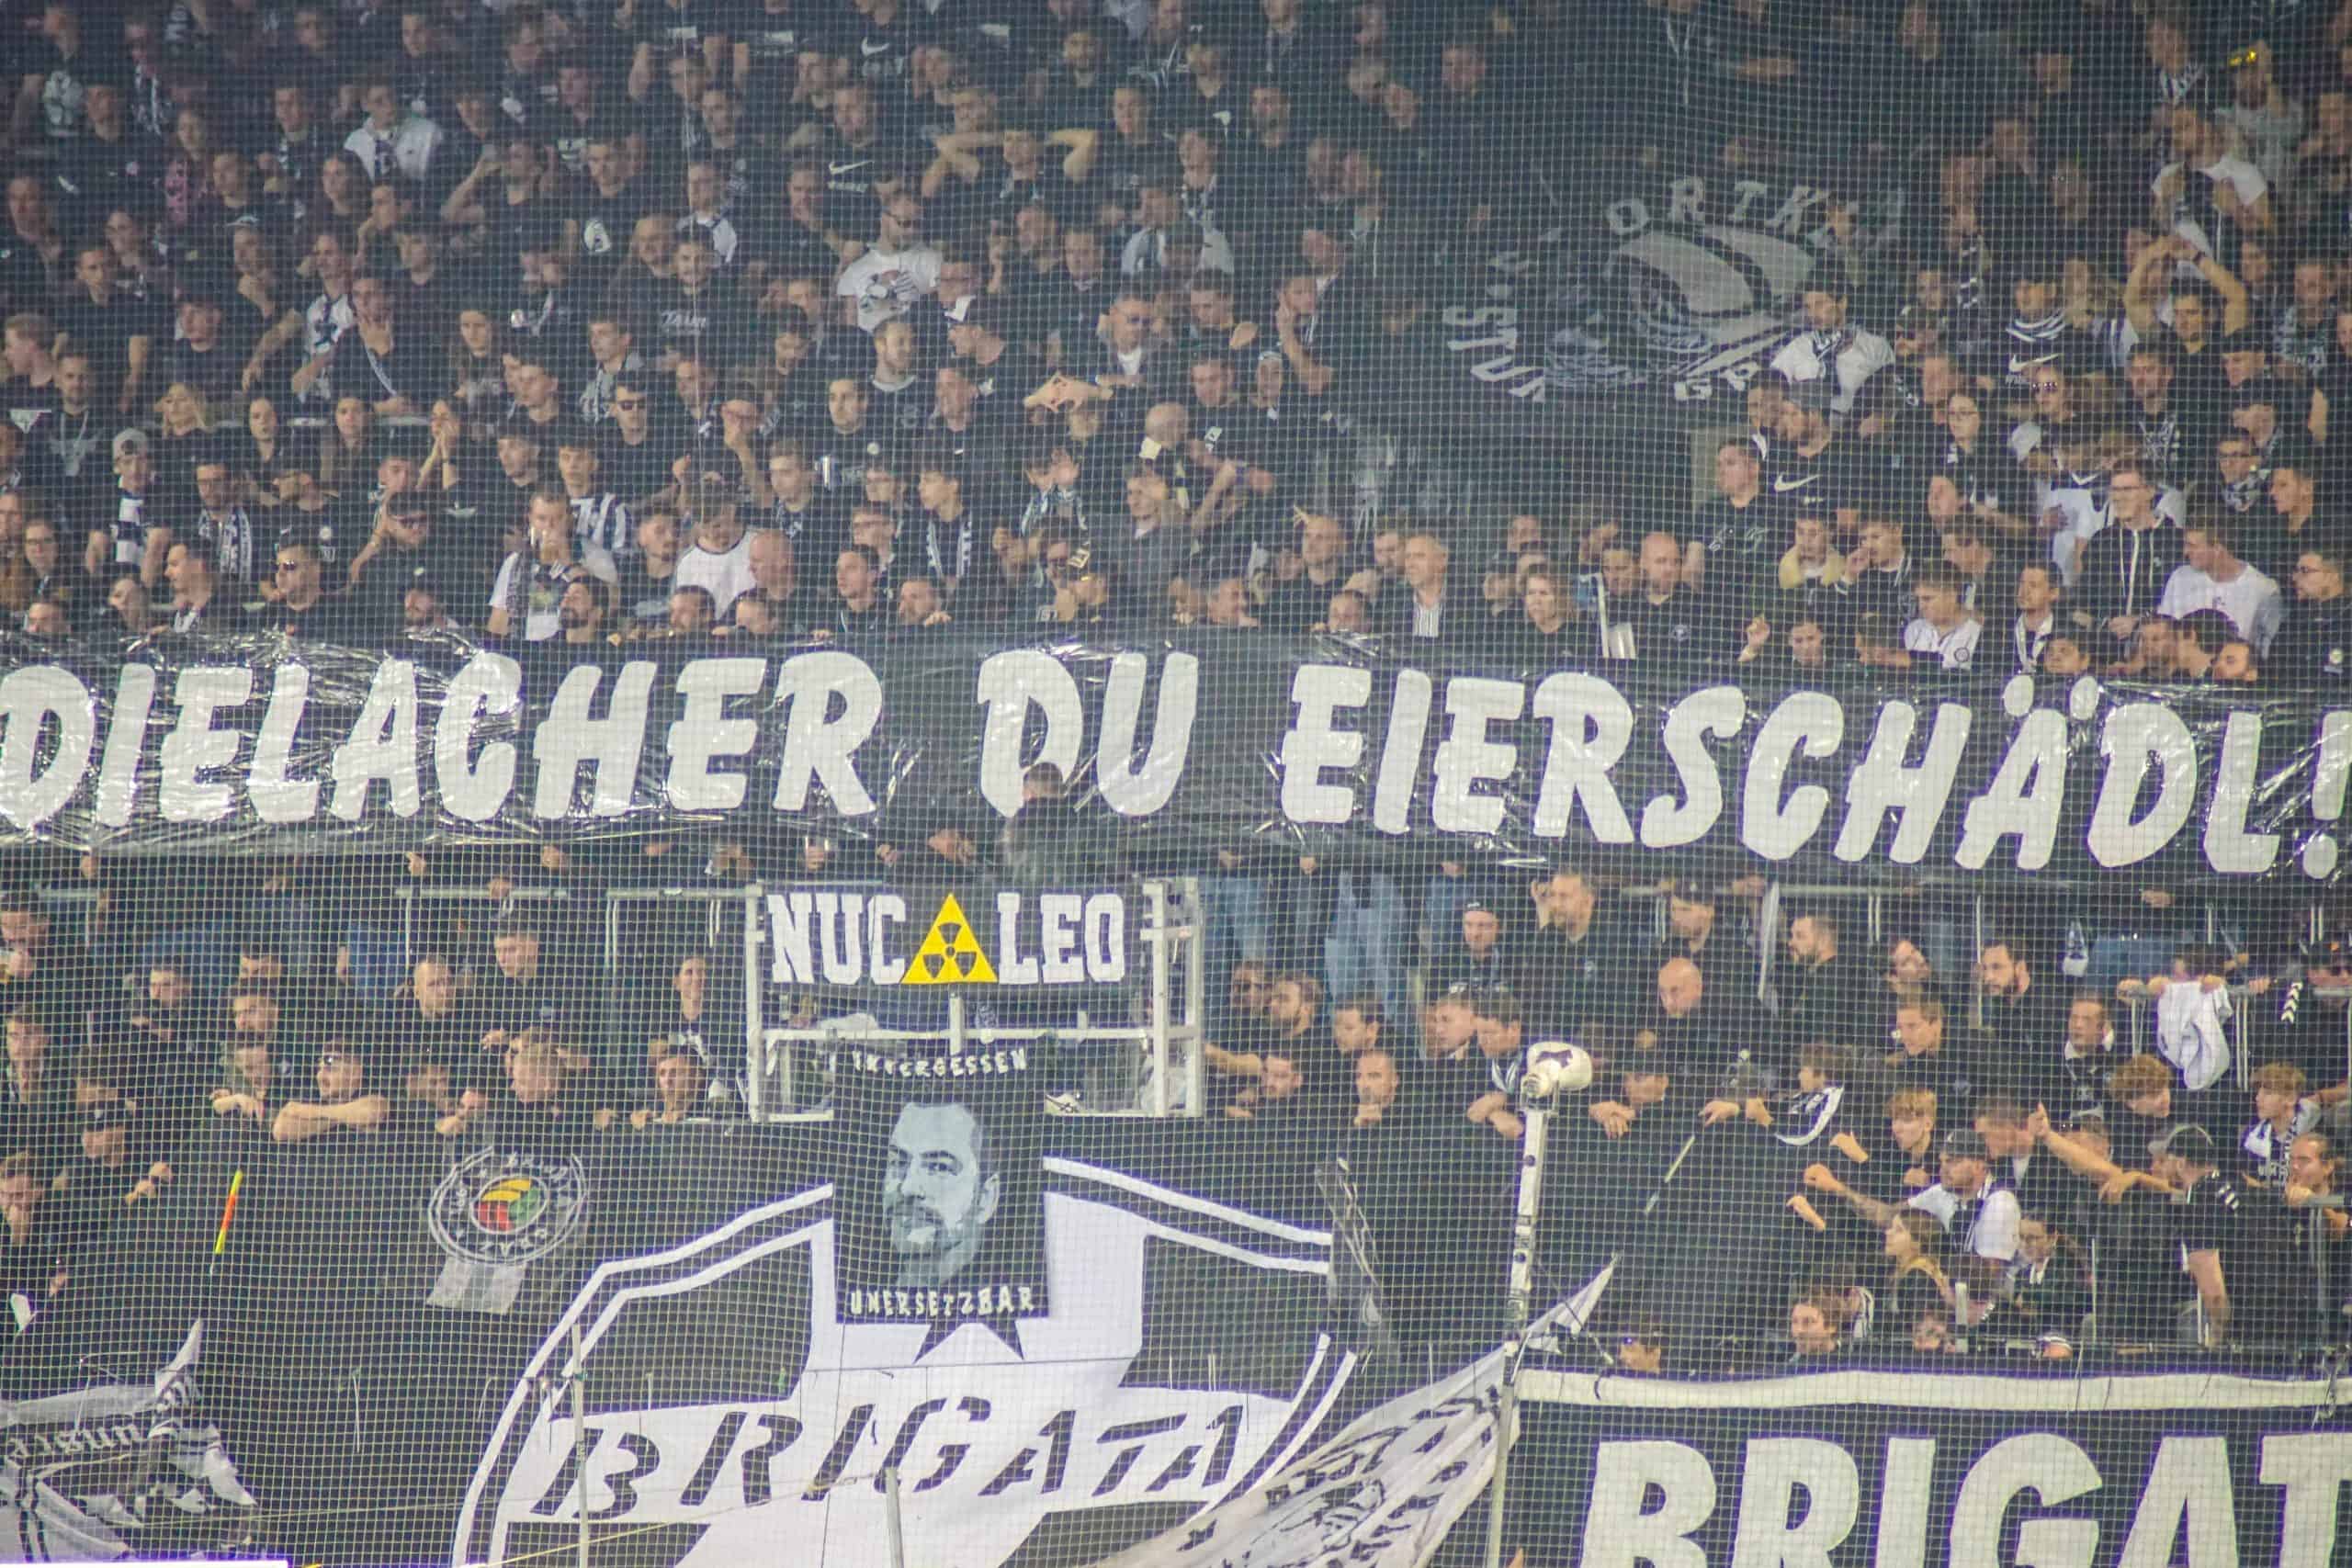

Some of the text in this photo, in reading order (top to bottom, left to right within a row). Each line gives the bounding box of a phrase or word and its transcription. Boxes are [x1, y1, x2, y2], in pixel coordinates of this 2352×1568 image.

[0, 649, 2352, 879] DIELACHER DU EIERSCHÄDL!
[766, 892, 1125, 985] NUC LEO
[850, 1285, 1035, 1317] UNERSETZBAR
[530, 1395, 1244, 1520] BRIGATA
